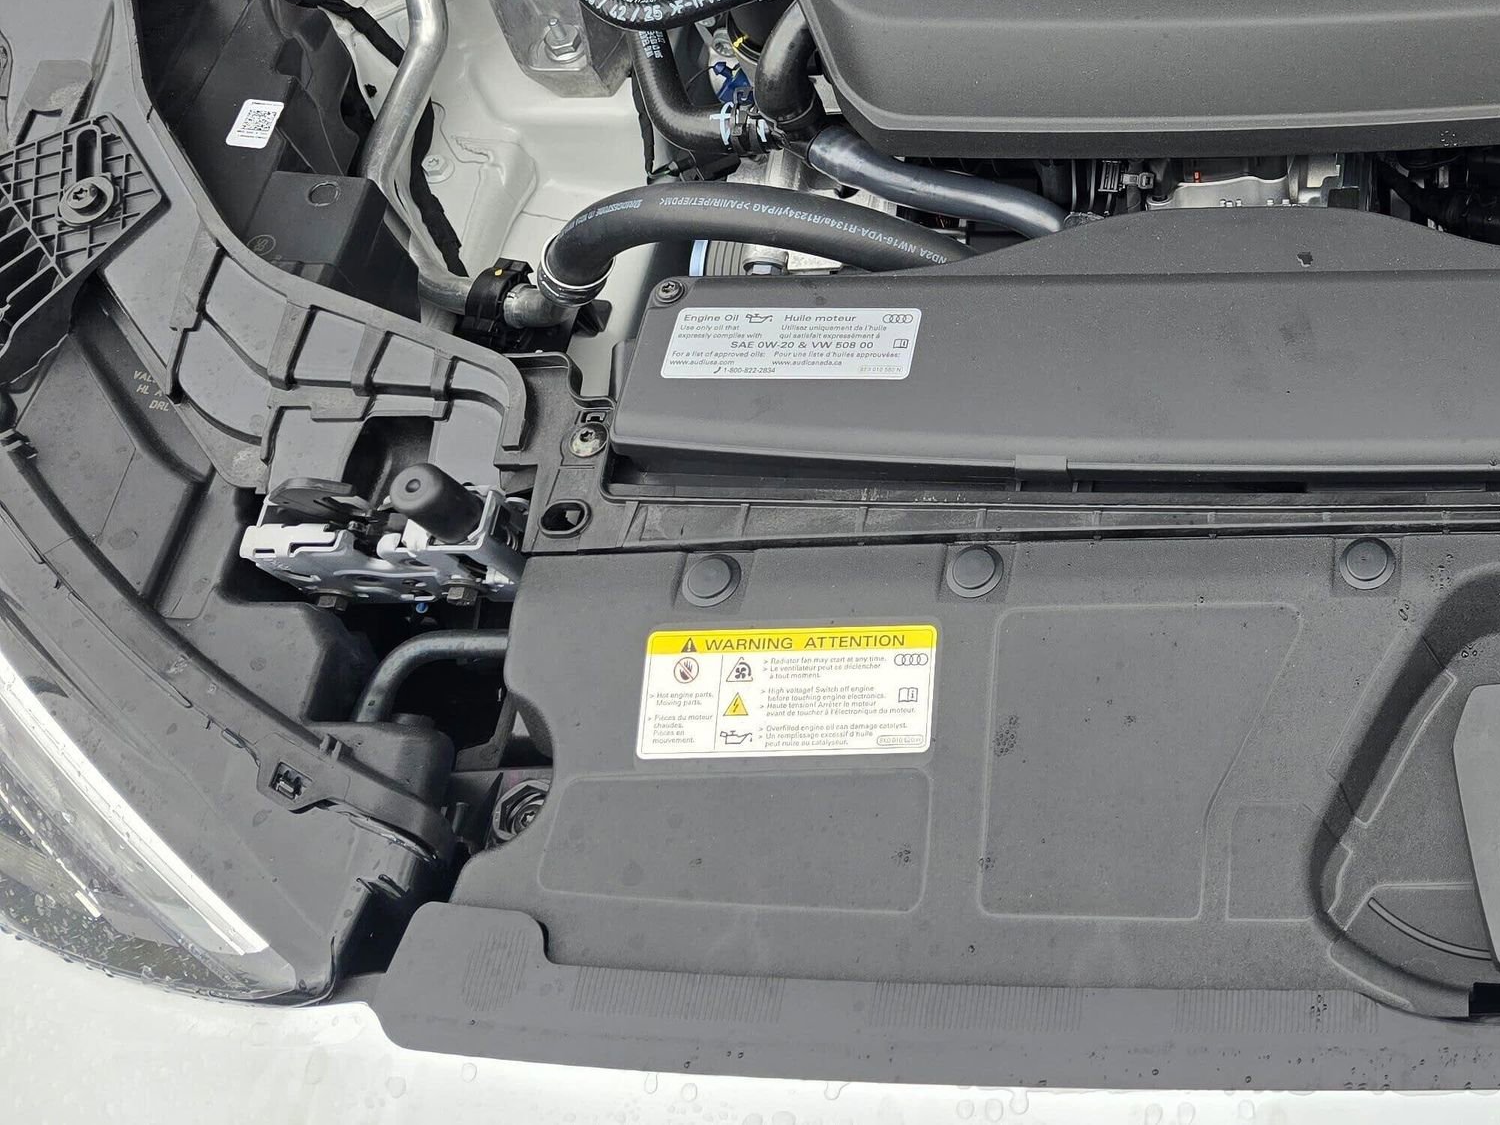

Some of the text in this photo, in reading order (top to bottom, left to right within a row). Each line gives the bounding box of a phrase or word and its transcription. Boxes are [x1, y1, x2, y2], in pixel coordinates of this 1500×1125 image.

[609, 5, 626, 21] 42
[644, 4, 662, 21] 25
[684, 314, 739, 323] Engine Oil
[784, 314, 857, 322] Huile moteur
[809, 325, 852, 333] uniquement
[714, 351, 749, 359] approved
[149, 399, 169, 412] DRL
[705, 634, 906, 651] WARNING ATTENTION
